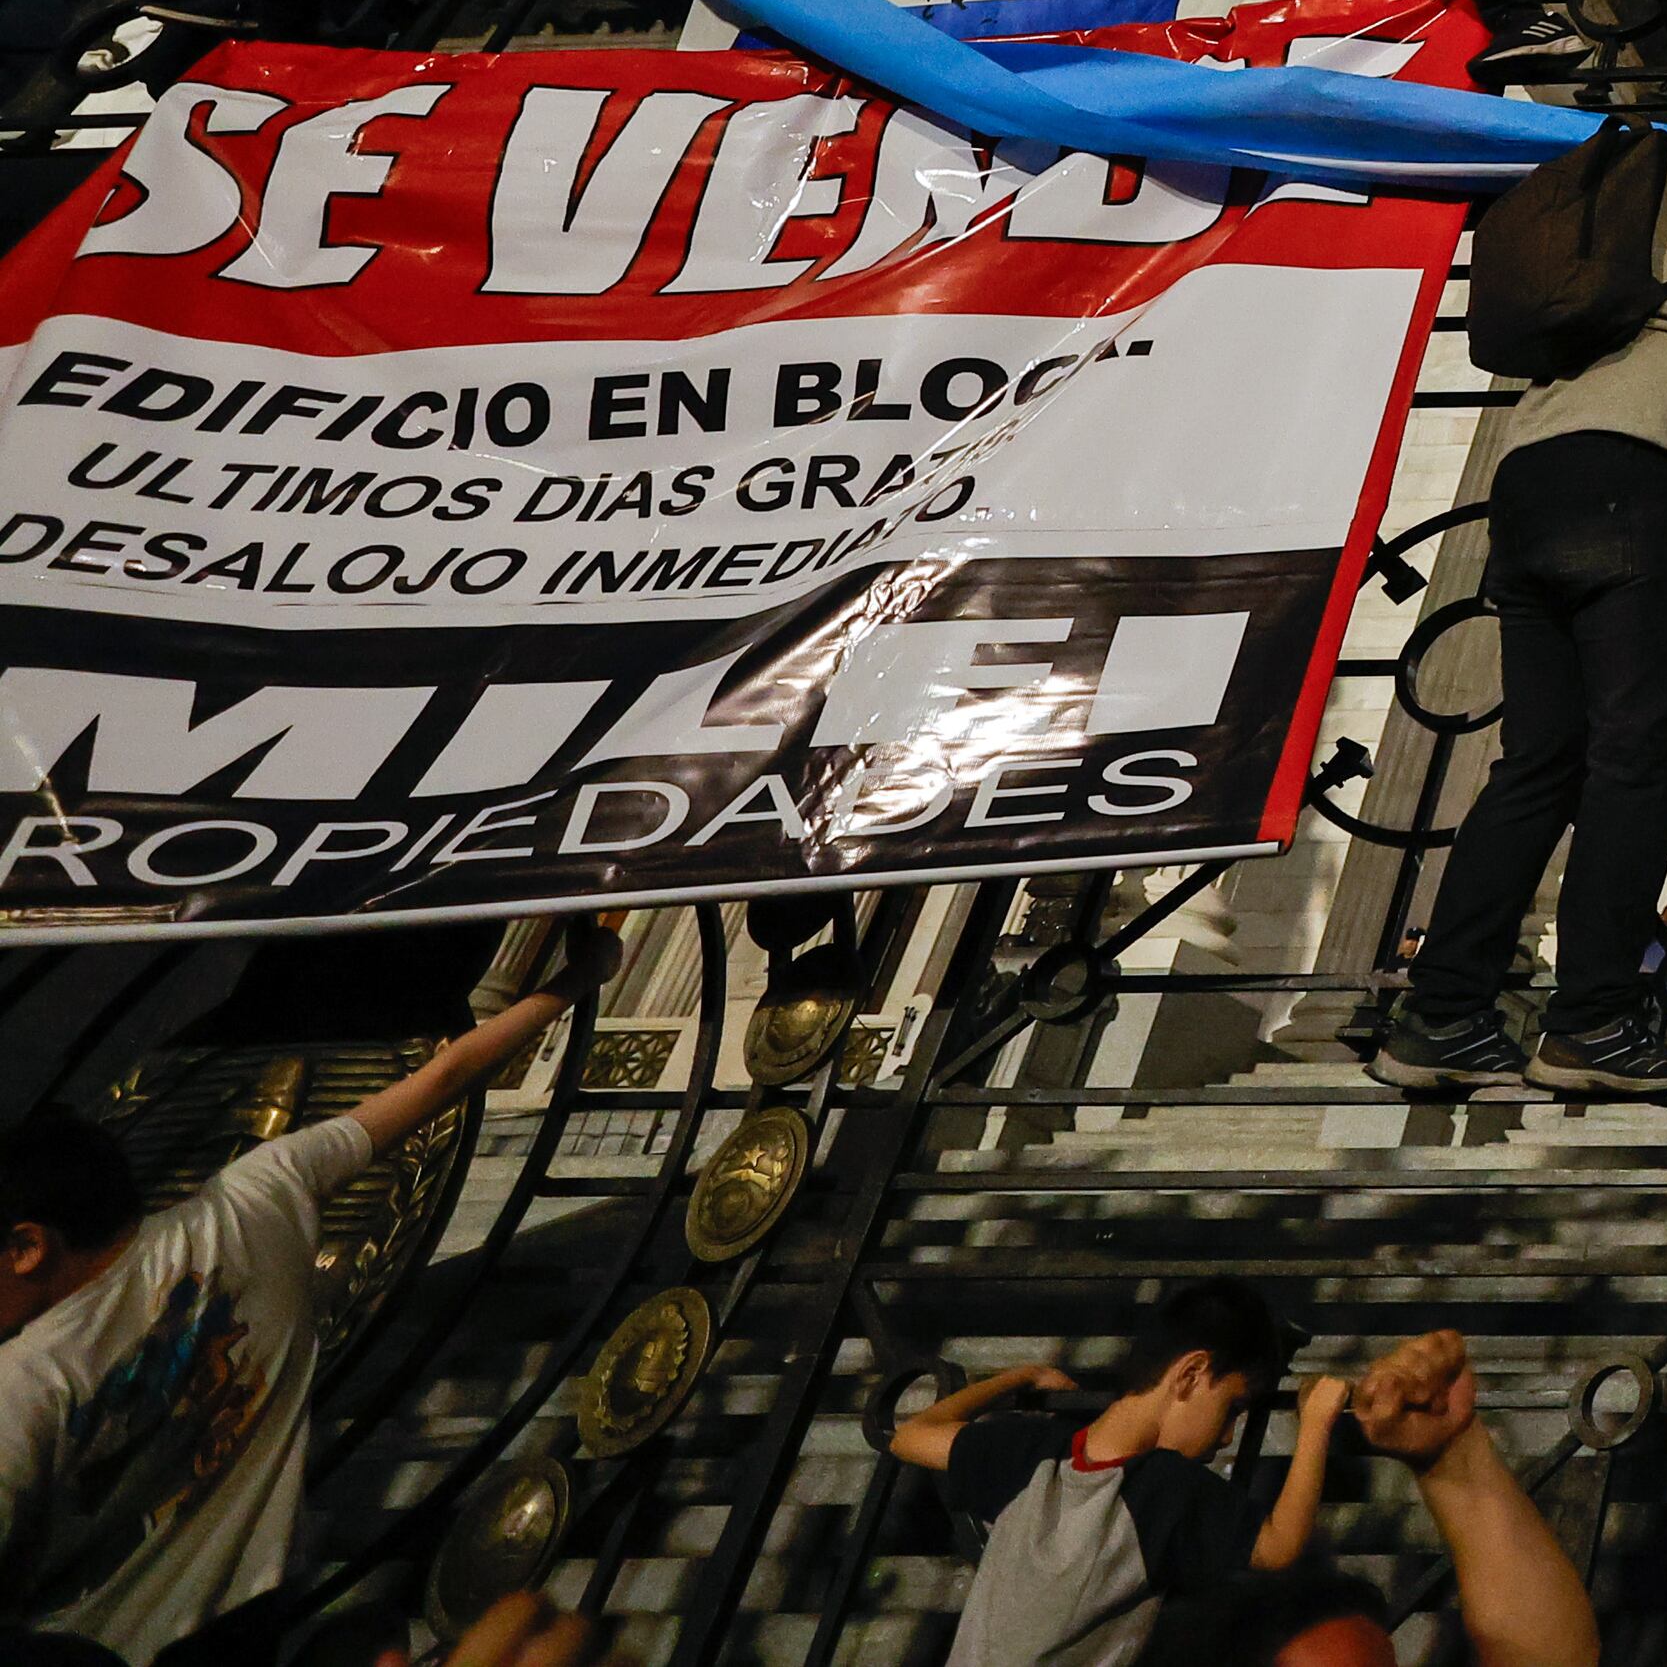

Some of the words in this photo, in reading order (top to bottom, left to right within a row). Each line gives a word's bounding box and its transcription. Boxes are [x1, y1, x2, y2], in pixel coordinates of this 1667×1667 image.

[73, 82, 453, 290] SE
[17, 351, 551, 451] EDIFICIO
[587, 367, 733, 441] EN
[772, 340, 1154, 428] BLOC
[67, 442, 503, 522] ULTIMOS
[0, 513, 527, 596] DESALOJO
[0, 611, 1251, 801] MILEI
